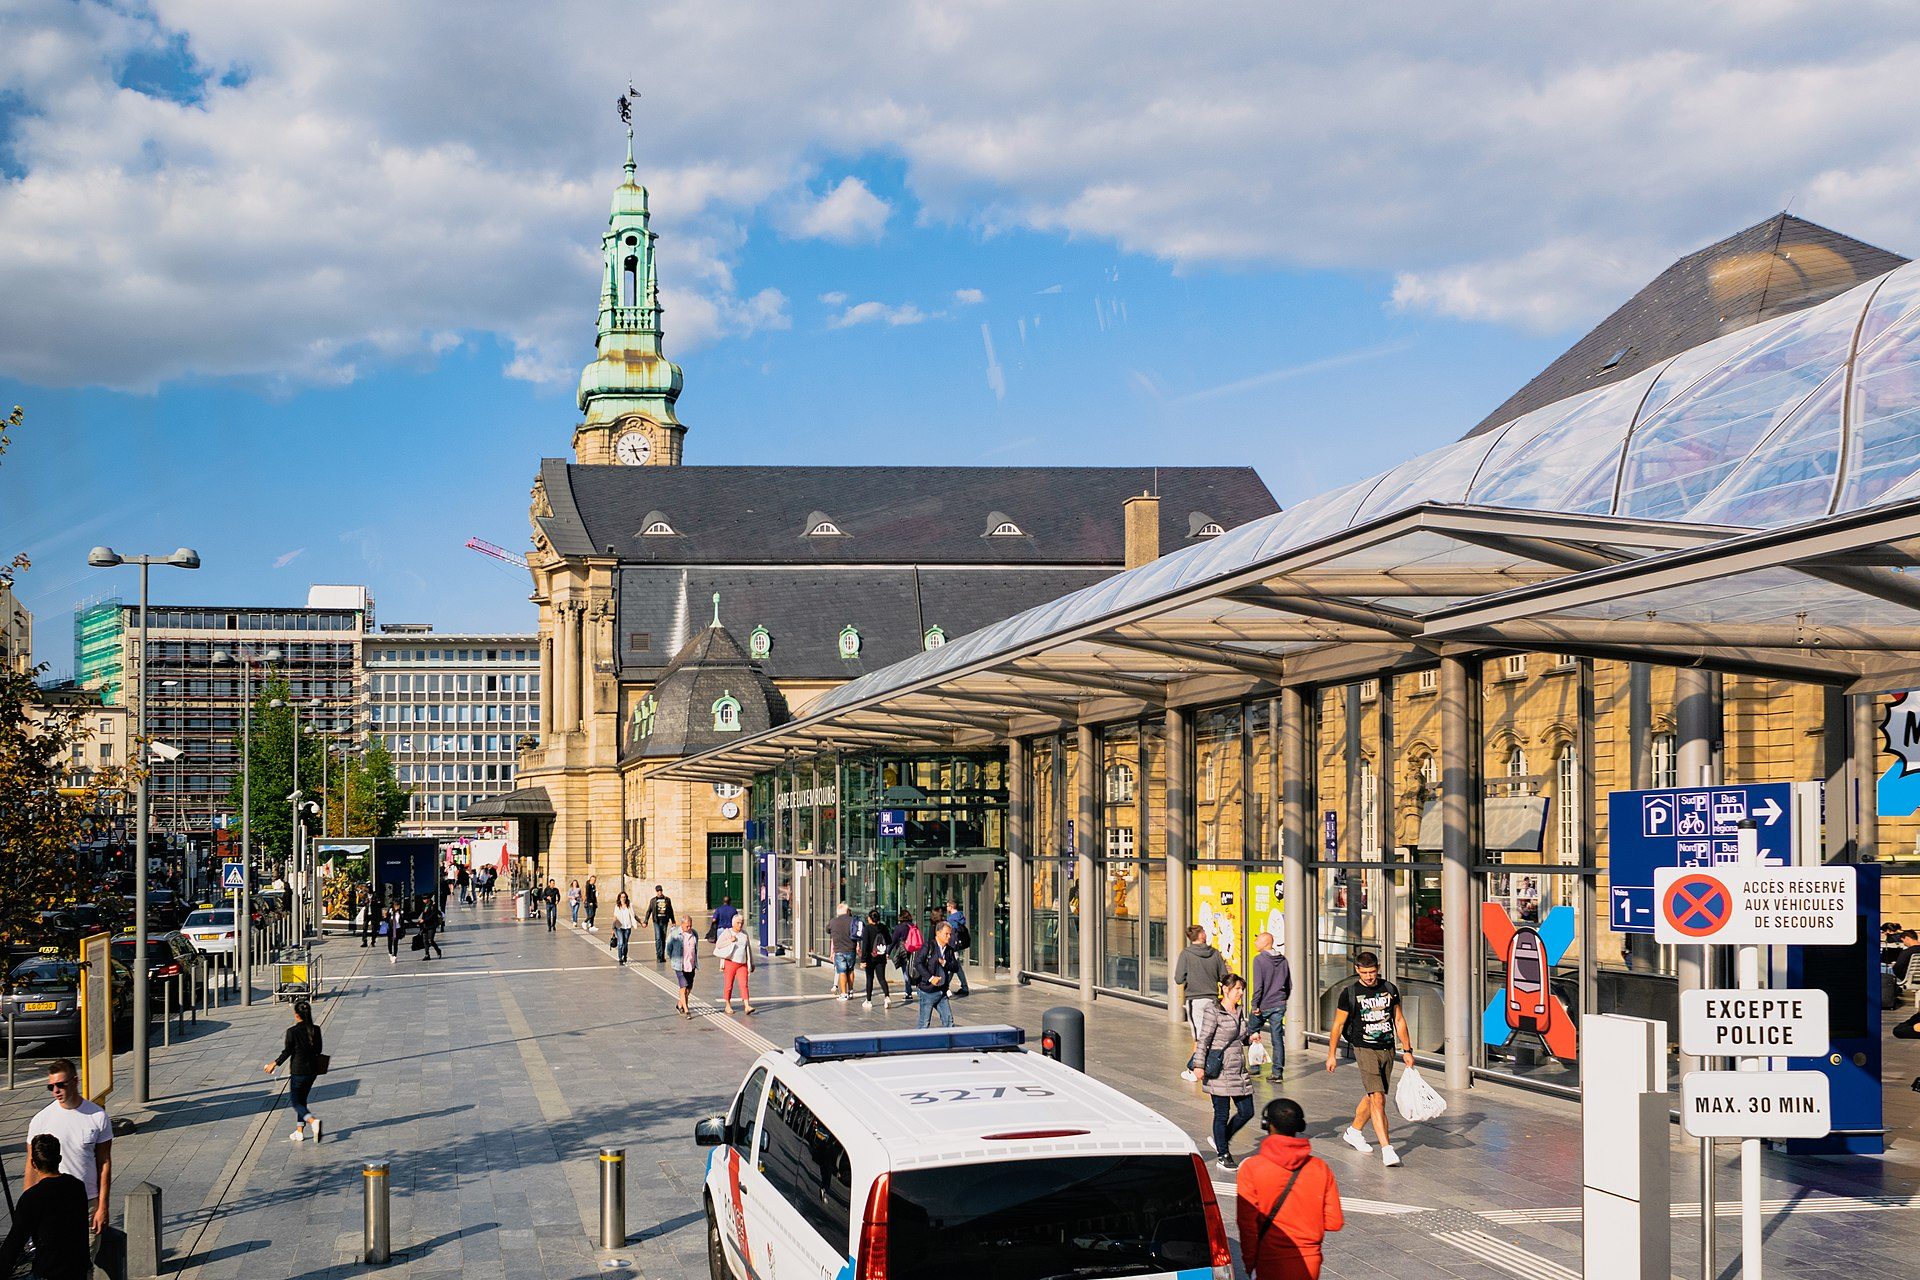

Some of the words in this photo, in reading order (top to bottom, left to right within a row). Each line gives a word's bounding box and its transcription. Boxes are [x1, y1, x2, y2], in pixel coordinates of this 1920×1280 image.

[777, 792, 789, 809] GARE
[790, 791, 796, 808] DE
[796, 785, 836, 807] LUXEMBOURG
[1681, 796, 1696, 805] Sud
[1721, 794, 1737, 803] Bus
[1651, 807, 1667, 834] P
[883, 826, 903, 834] 4-10
[1680, 844, 1697, 852] Nord
[1722, 843, 1738, 852] Bus
[1743, 878, 1784, 894] ACCÈS
[1789, 878, 1846, 894] RÉSERVÉ
[1745, 899, 1770, 911] AUX
[1774, 896, 1844, 911] VÉHICULES
[1755, 916, 1771, 929] DE
[1775, 916, 1834, 929] SECOURS
[1706, 1000, 1803, 1019] EXCEPTE
[1717, 1026, 1793, 1044] POLICE
[900, 1086, 1055, 1105] 3275
[1696, 1097, 1741, 1113] MAX.
[1748, 1097, 1771, 1113] 30
[1779, 1097, 1820, 1113] MIN.
